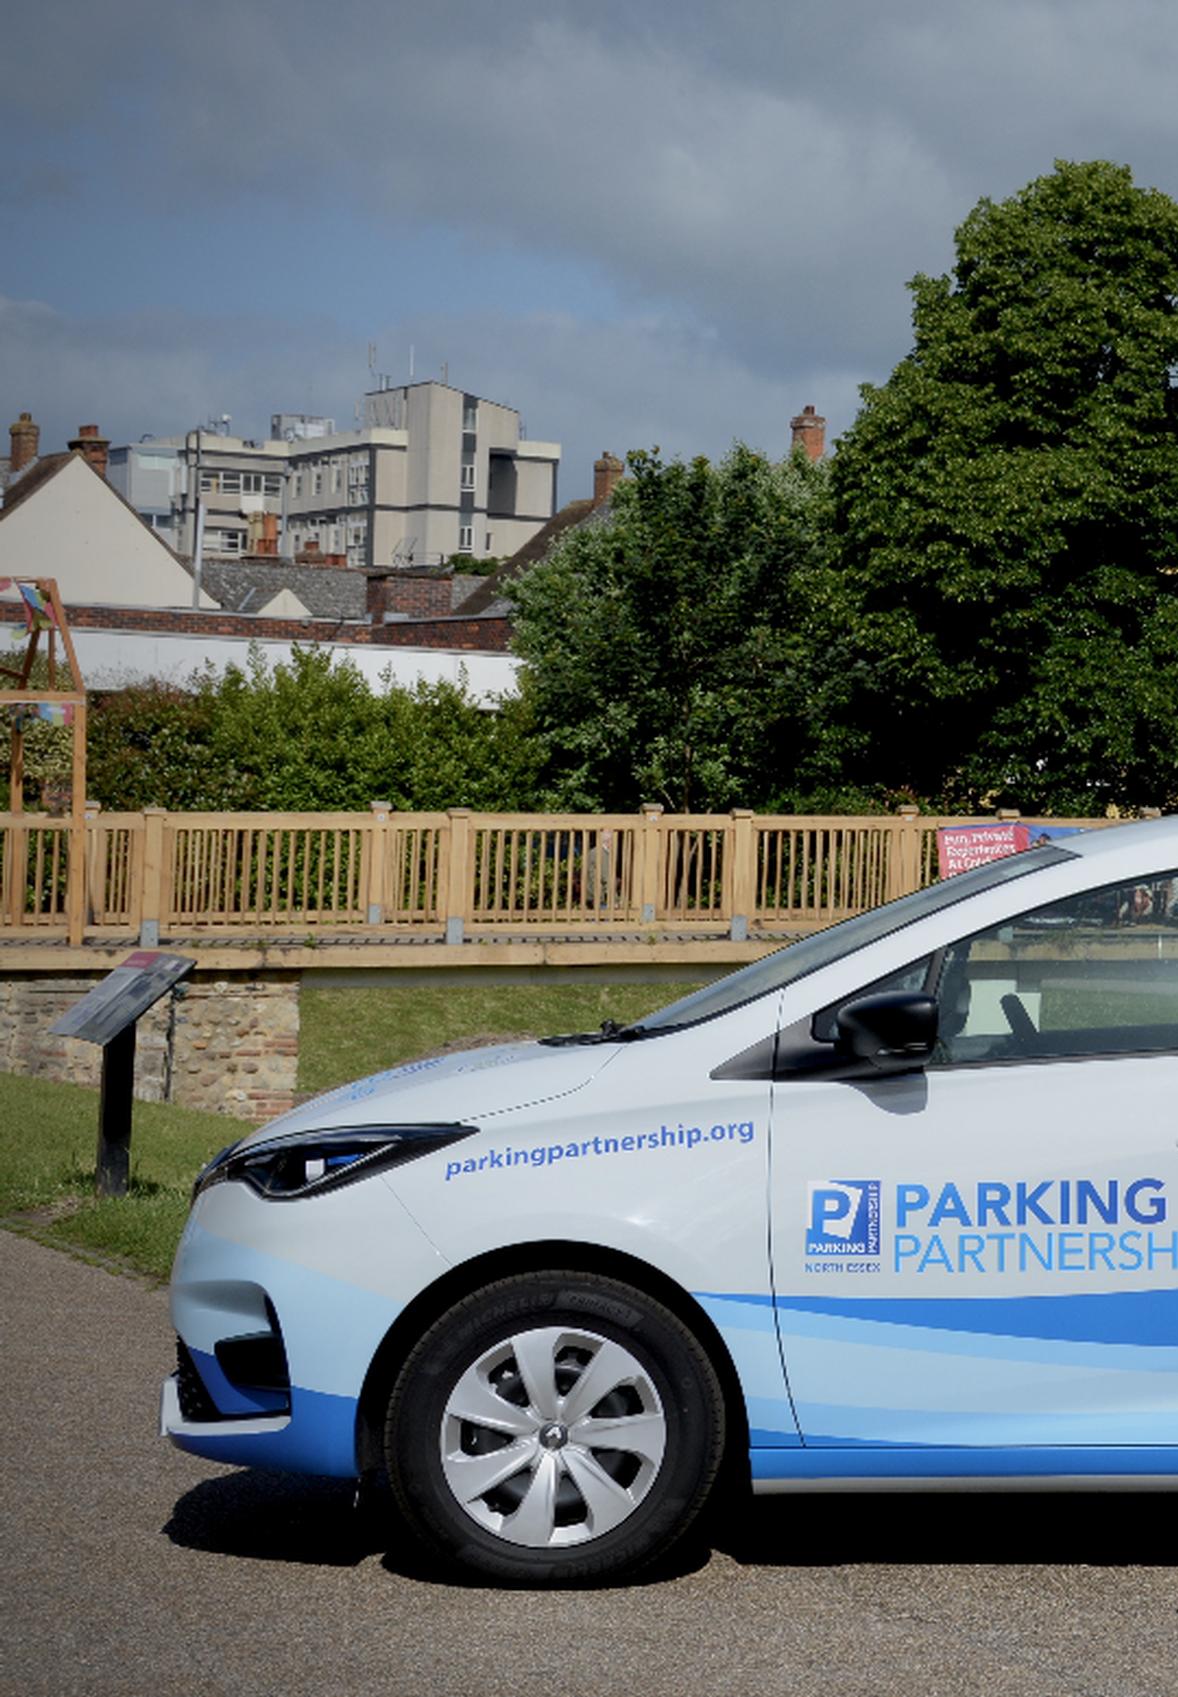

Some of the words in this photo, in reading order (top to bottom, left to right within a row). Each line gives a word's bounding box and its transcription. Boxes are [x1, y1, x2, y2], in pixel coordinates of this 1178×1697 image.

[445, 1121, 755, 1181] parkingpartnership.org
[896, 1178, 1167, 1228] PARKING
[808, 1242, 866, 1254] PARKING
[804, 1262, 844, 1273] NORTH
[846, 1262, 881, 1273] ESSEX
